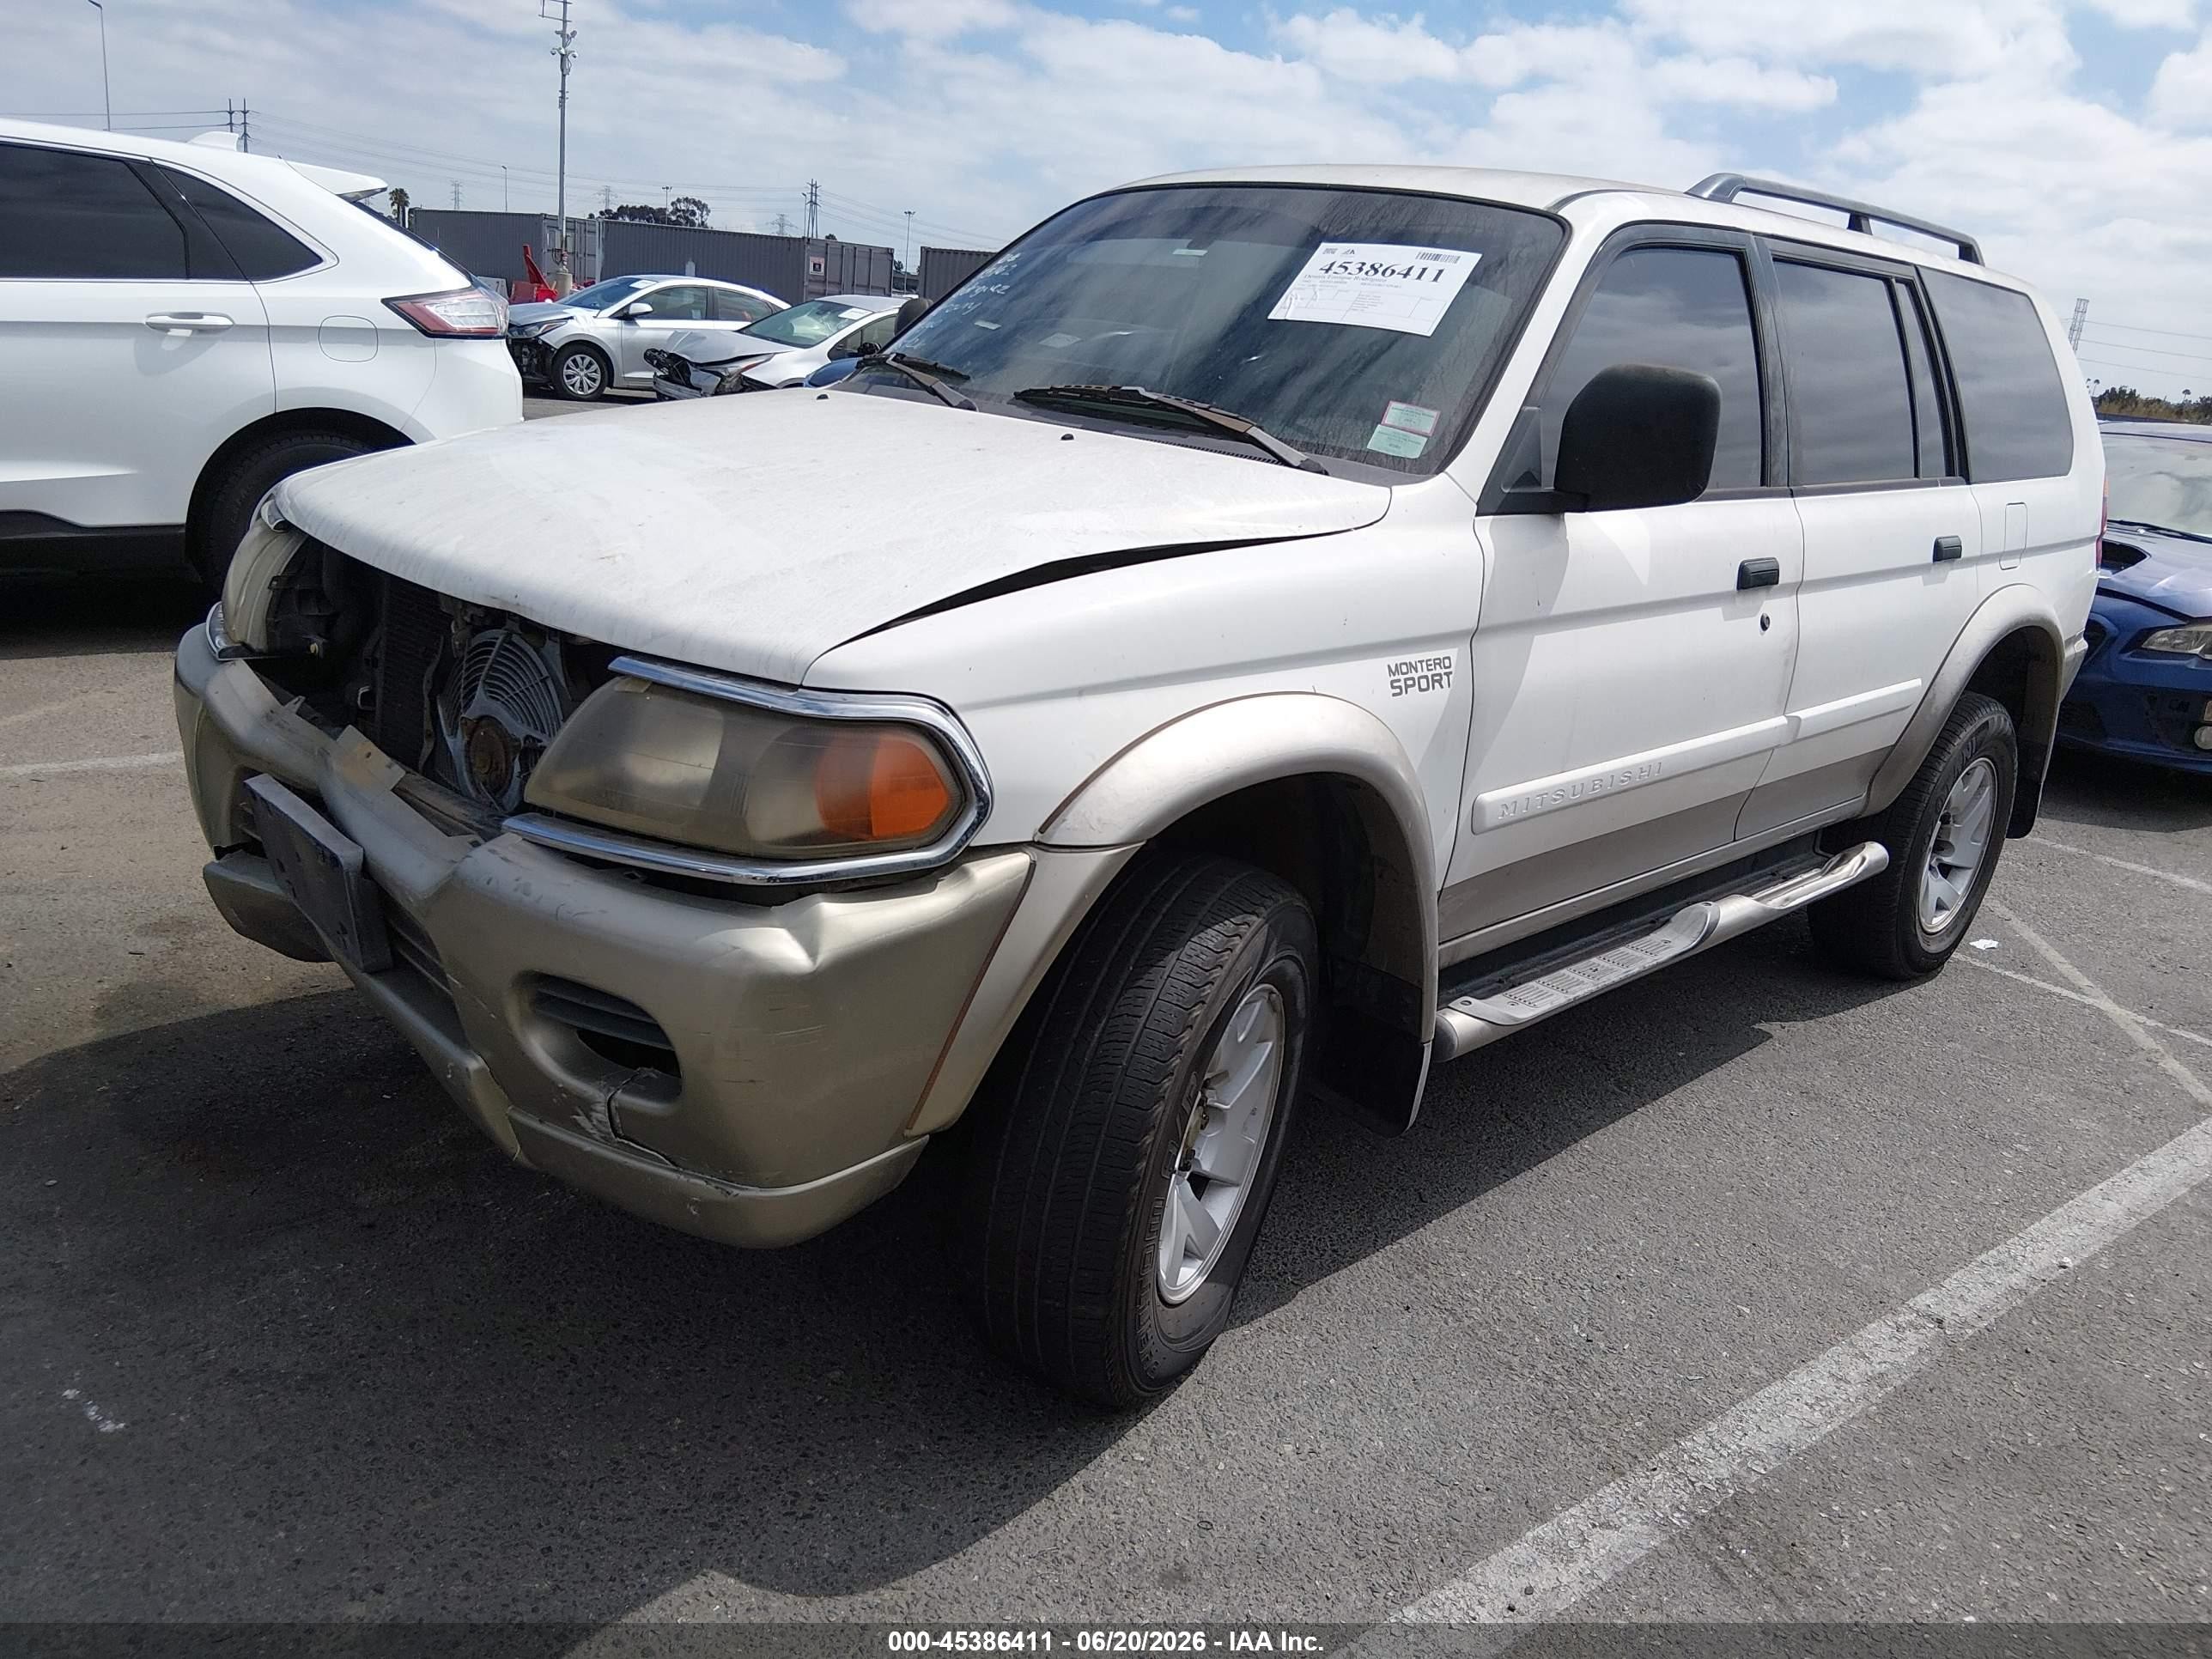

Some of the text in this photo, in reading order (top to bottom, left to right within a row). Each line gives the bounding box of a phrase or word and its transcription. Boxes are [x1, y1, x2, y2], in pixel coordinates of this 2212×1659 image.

[1319, 260, 1446, 283] 45386411
[1387, 656, 1452, 678] MONTERO
[1389, 672, 1453, 697] SPORT
[1498, 762, 1662, 820] MITSUBISHI
